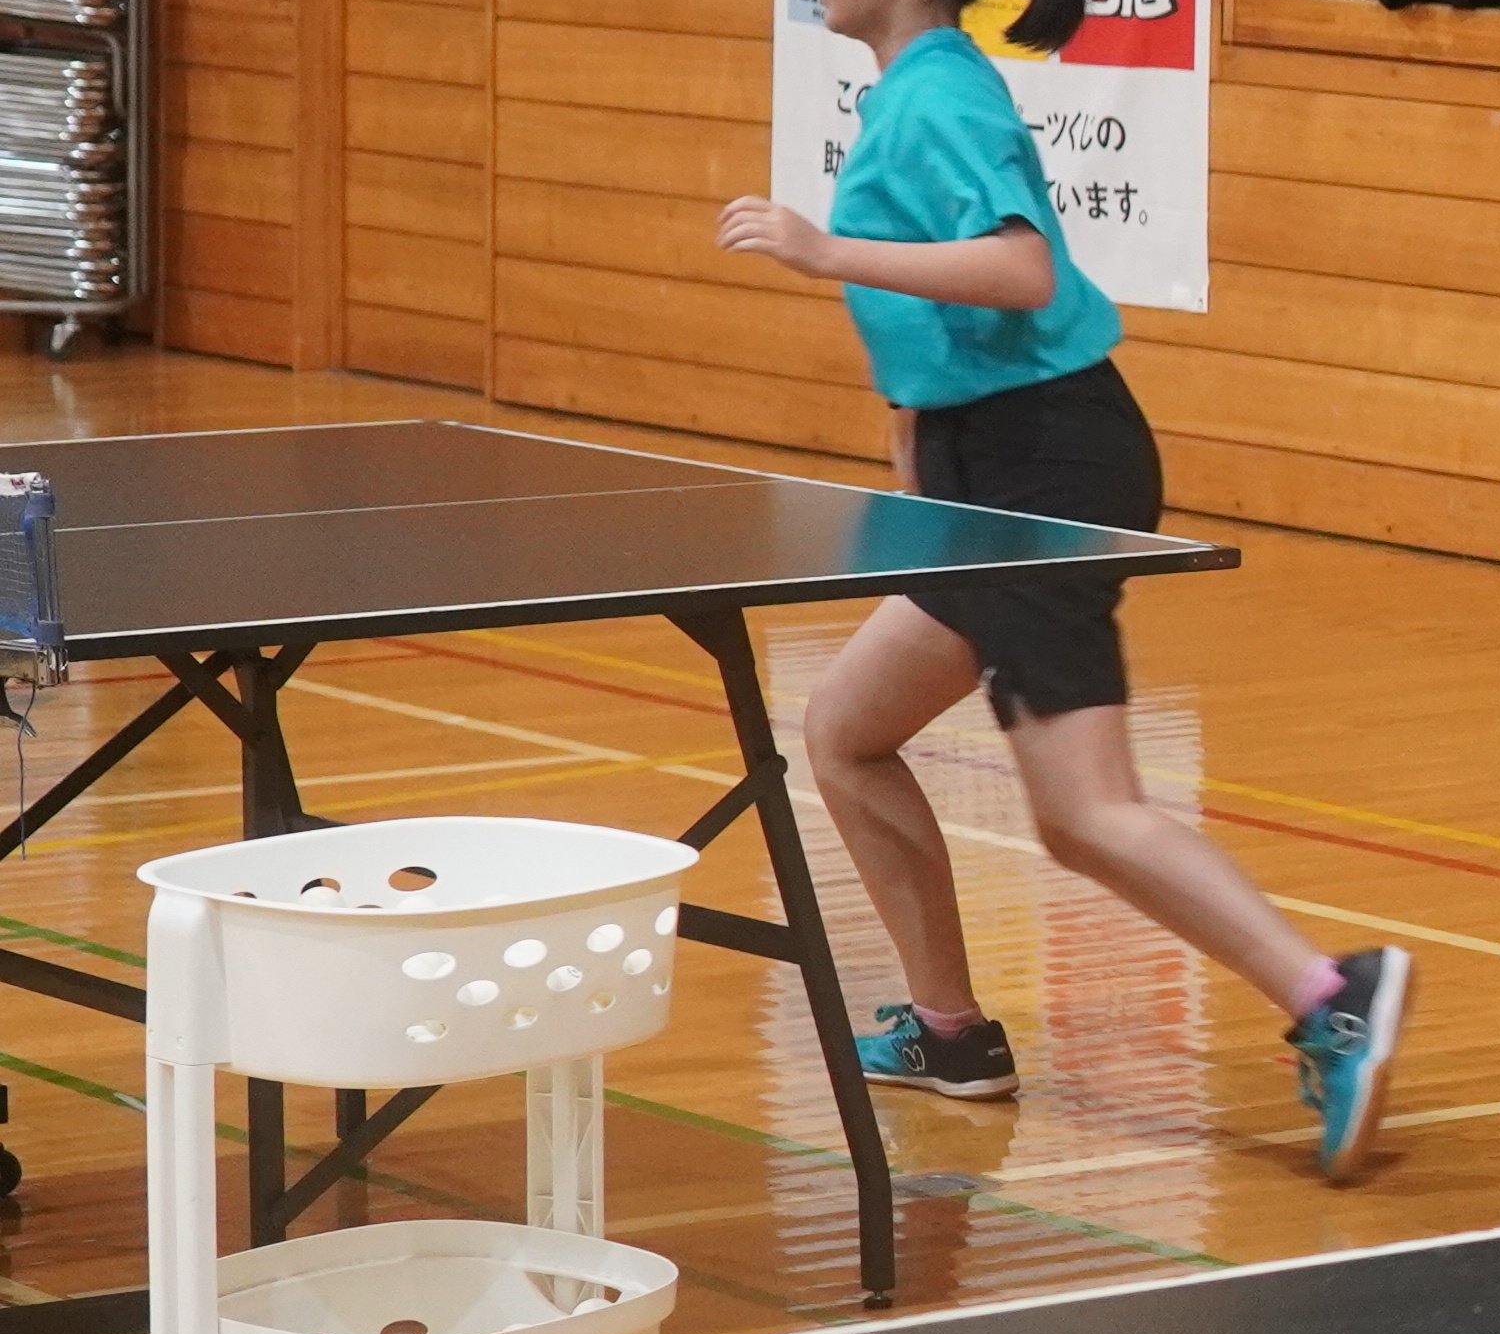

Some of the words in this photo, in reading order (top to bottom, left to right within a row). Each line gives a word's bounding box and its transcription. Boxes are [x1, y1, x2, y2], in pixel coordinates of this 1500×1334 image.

[1017, 103, 1126, 152] ーツくじの
